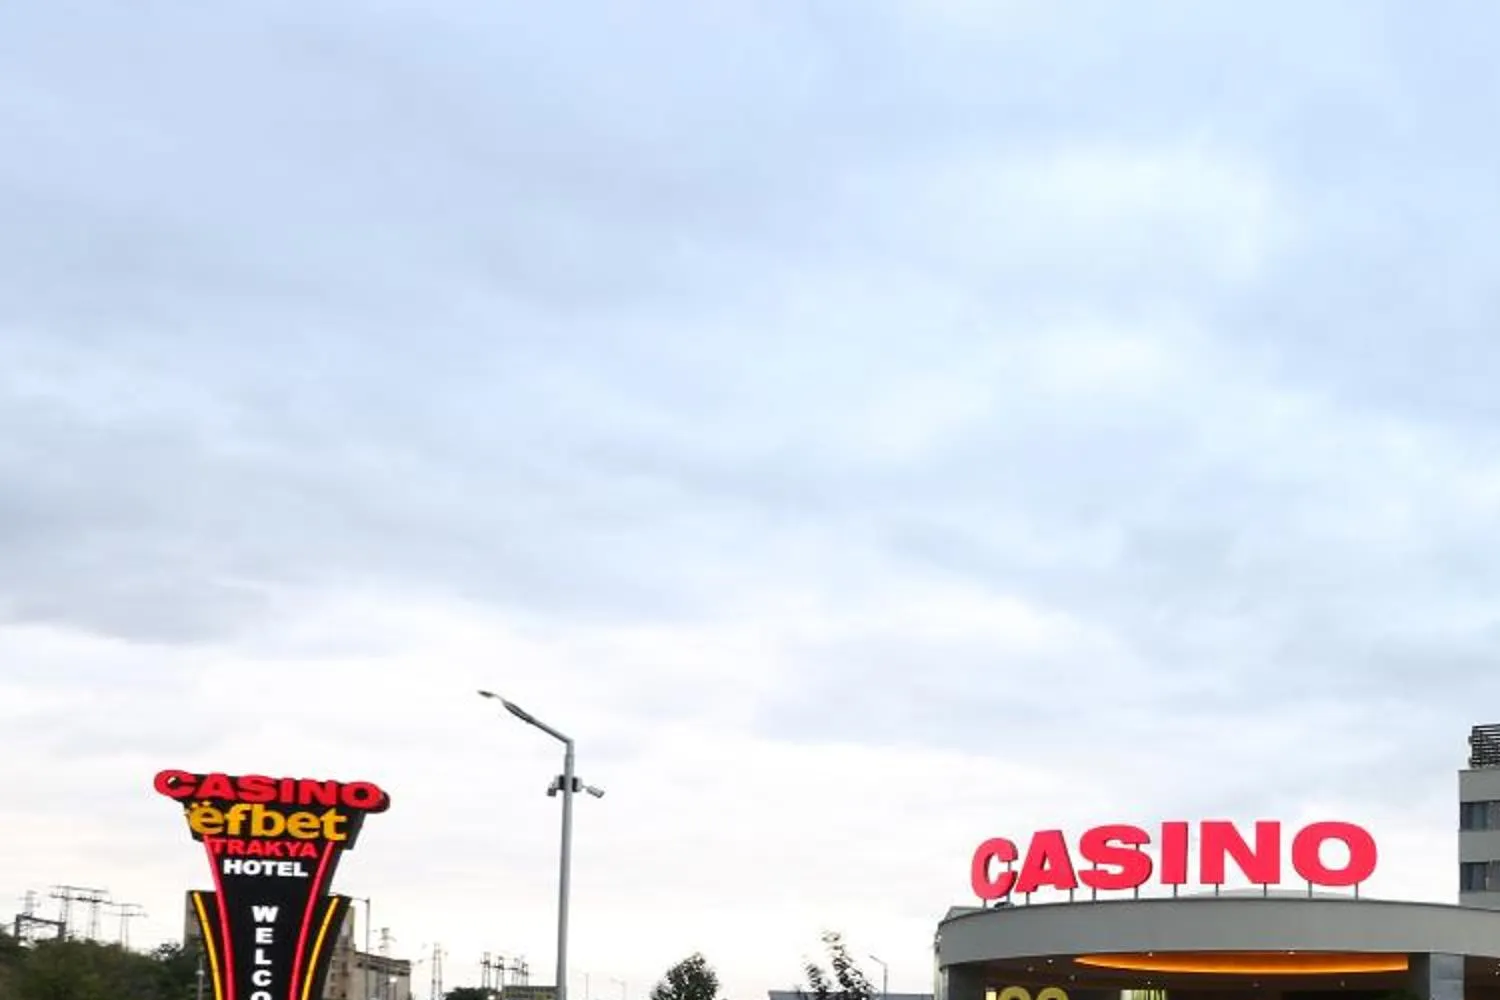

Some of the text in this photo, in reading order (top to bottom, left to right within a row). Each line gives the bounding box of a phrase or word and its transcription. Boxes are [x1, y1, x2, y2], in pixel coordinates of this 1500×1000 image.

[154, 769, 388, 810] CASINO
[211, 839, 318, 858] TRAKYA
[971, 821, 1377, 900] CASINO
[223, 859, 309, 878] HOTEL
